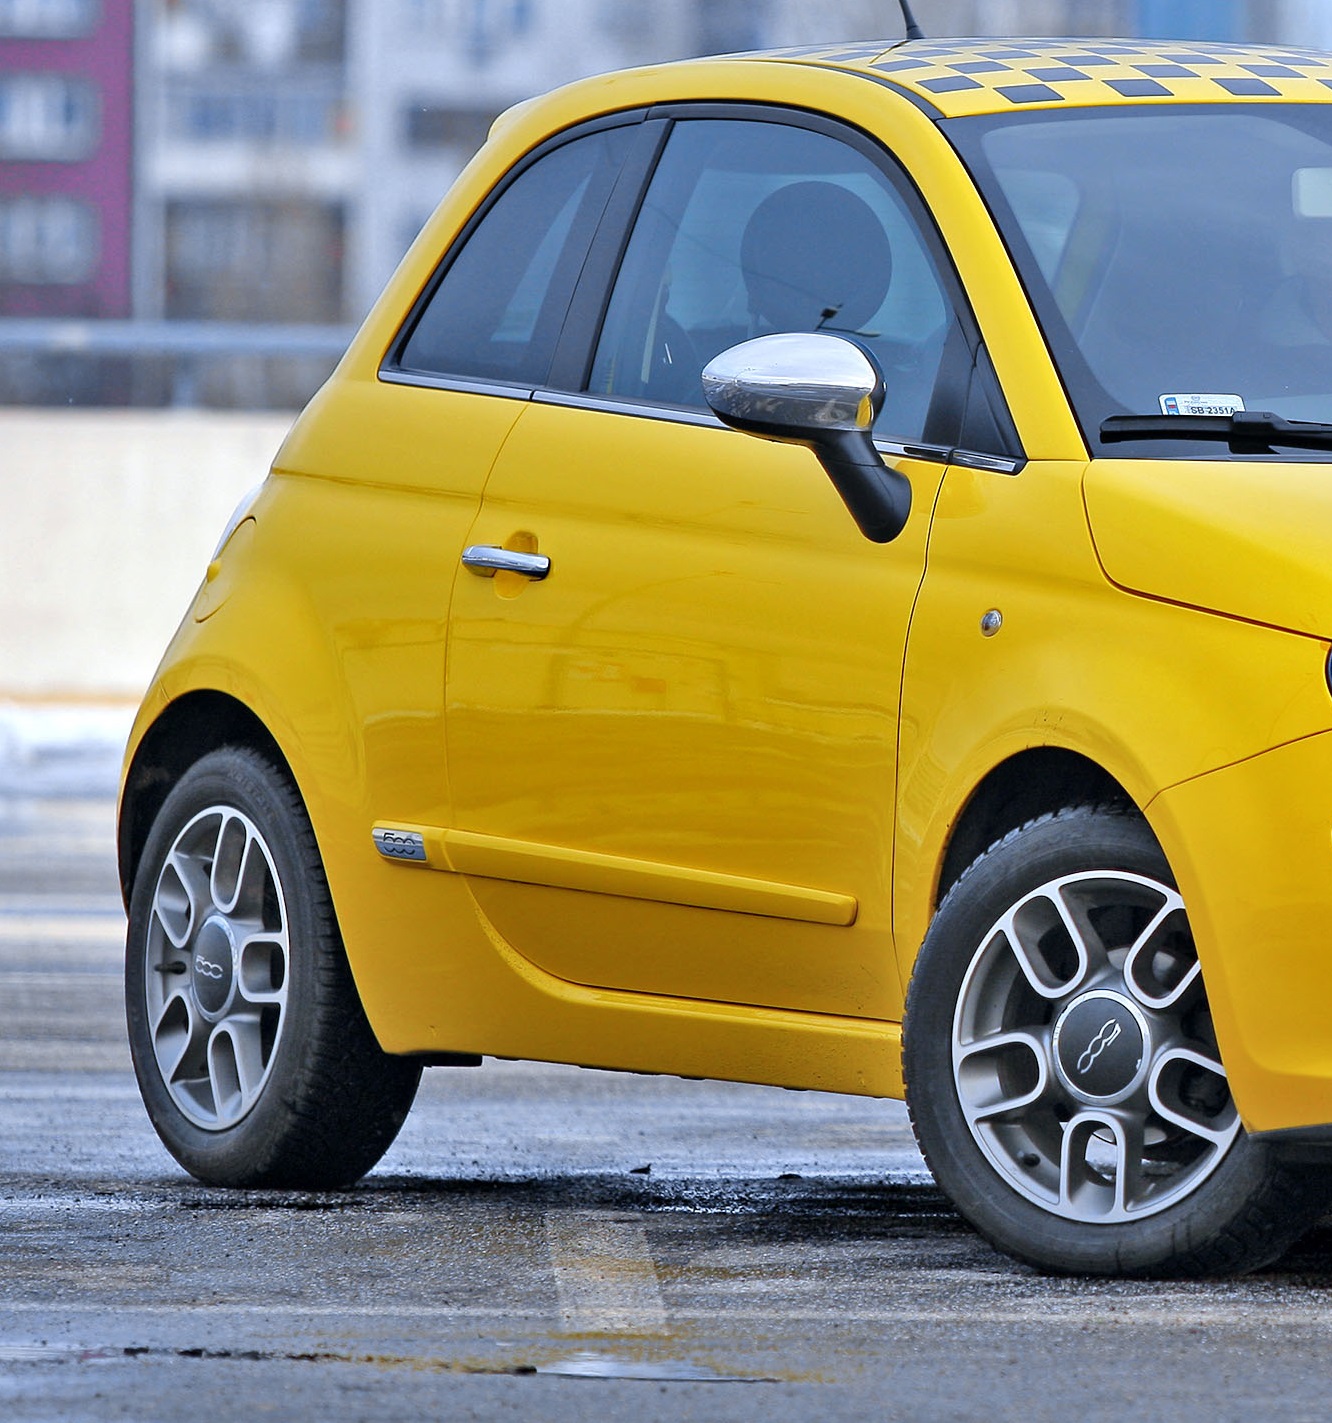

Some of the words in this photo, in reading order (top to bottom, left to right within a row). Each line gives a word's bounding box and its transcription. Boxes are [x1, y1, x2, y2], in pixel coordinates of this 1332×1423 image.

[1190, 406, 1205, 414] SB
[383, 832, 416, 855] 500
[195, 954, 224, 979] 500
[1077, 1018, 1121, 1074] 500
